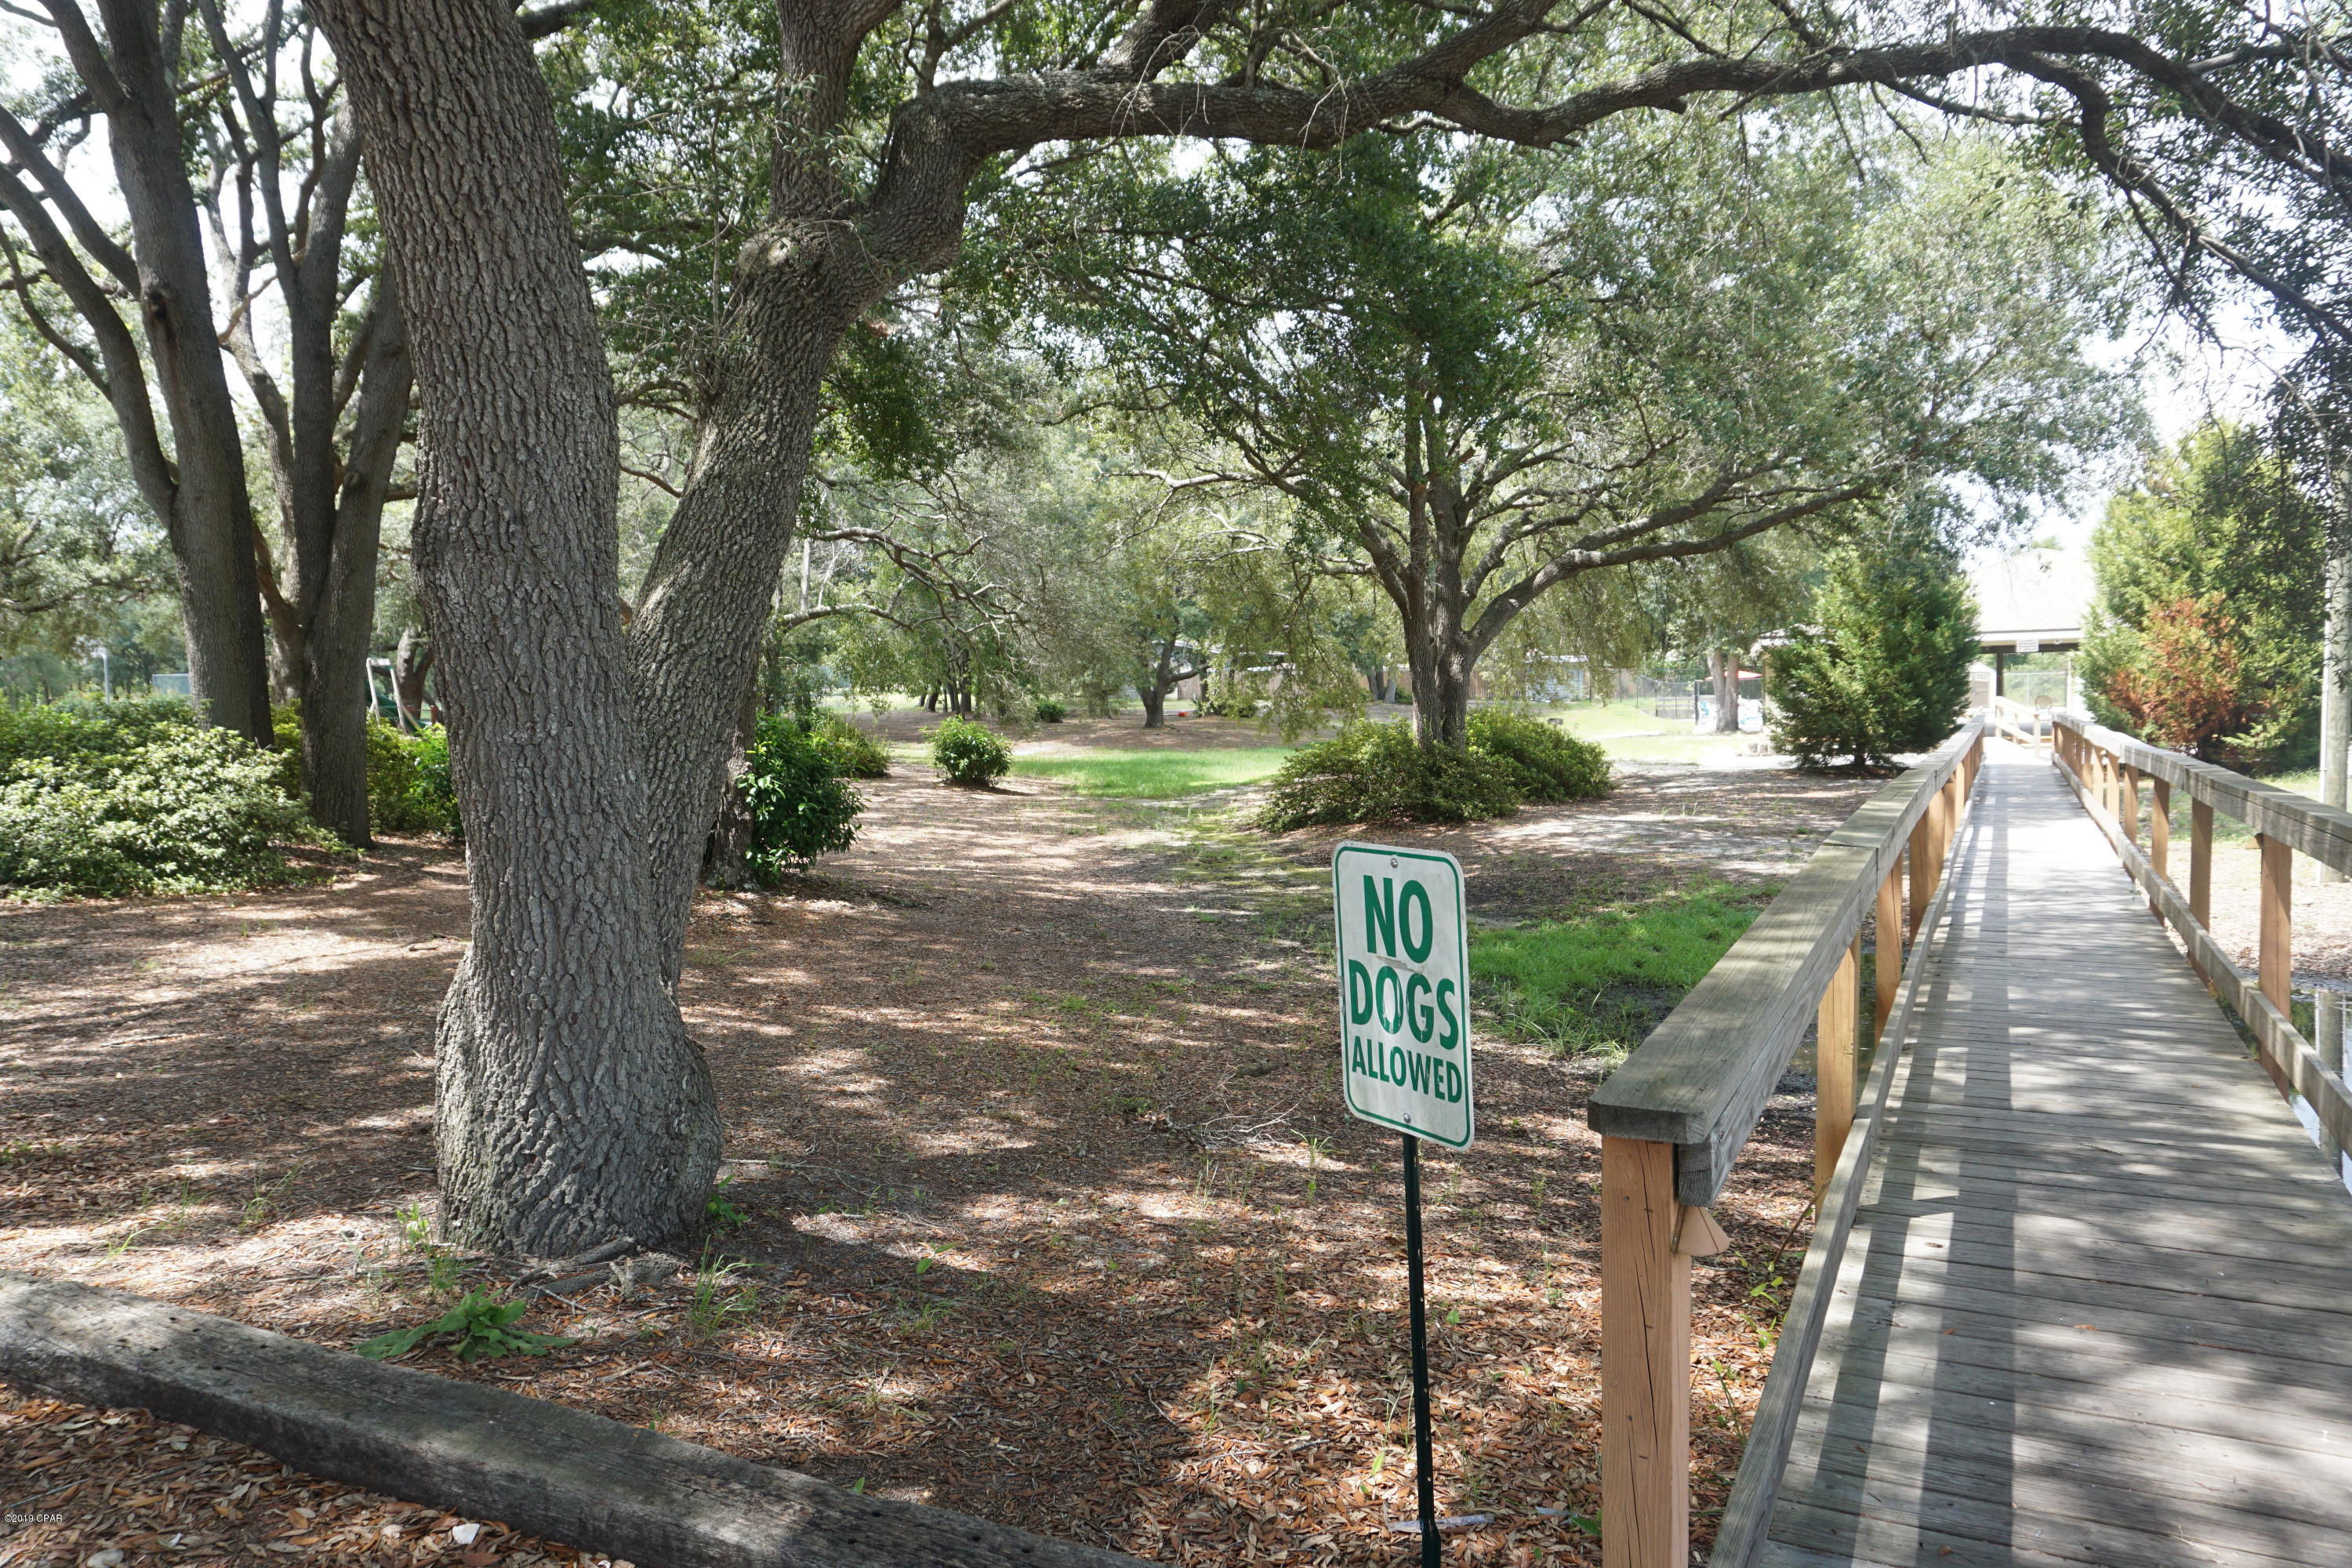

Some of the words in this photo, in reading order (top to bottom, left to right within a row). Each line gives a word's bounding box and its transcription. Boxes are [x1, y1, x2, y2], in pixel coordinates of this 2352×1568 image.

[1363, 874, 1434, 964] NO
[1348, 959, 1460, 1051] DOGS
[1351, 1035, 1463, 1104] ALLOWED
